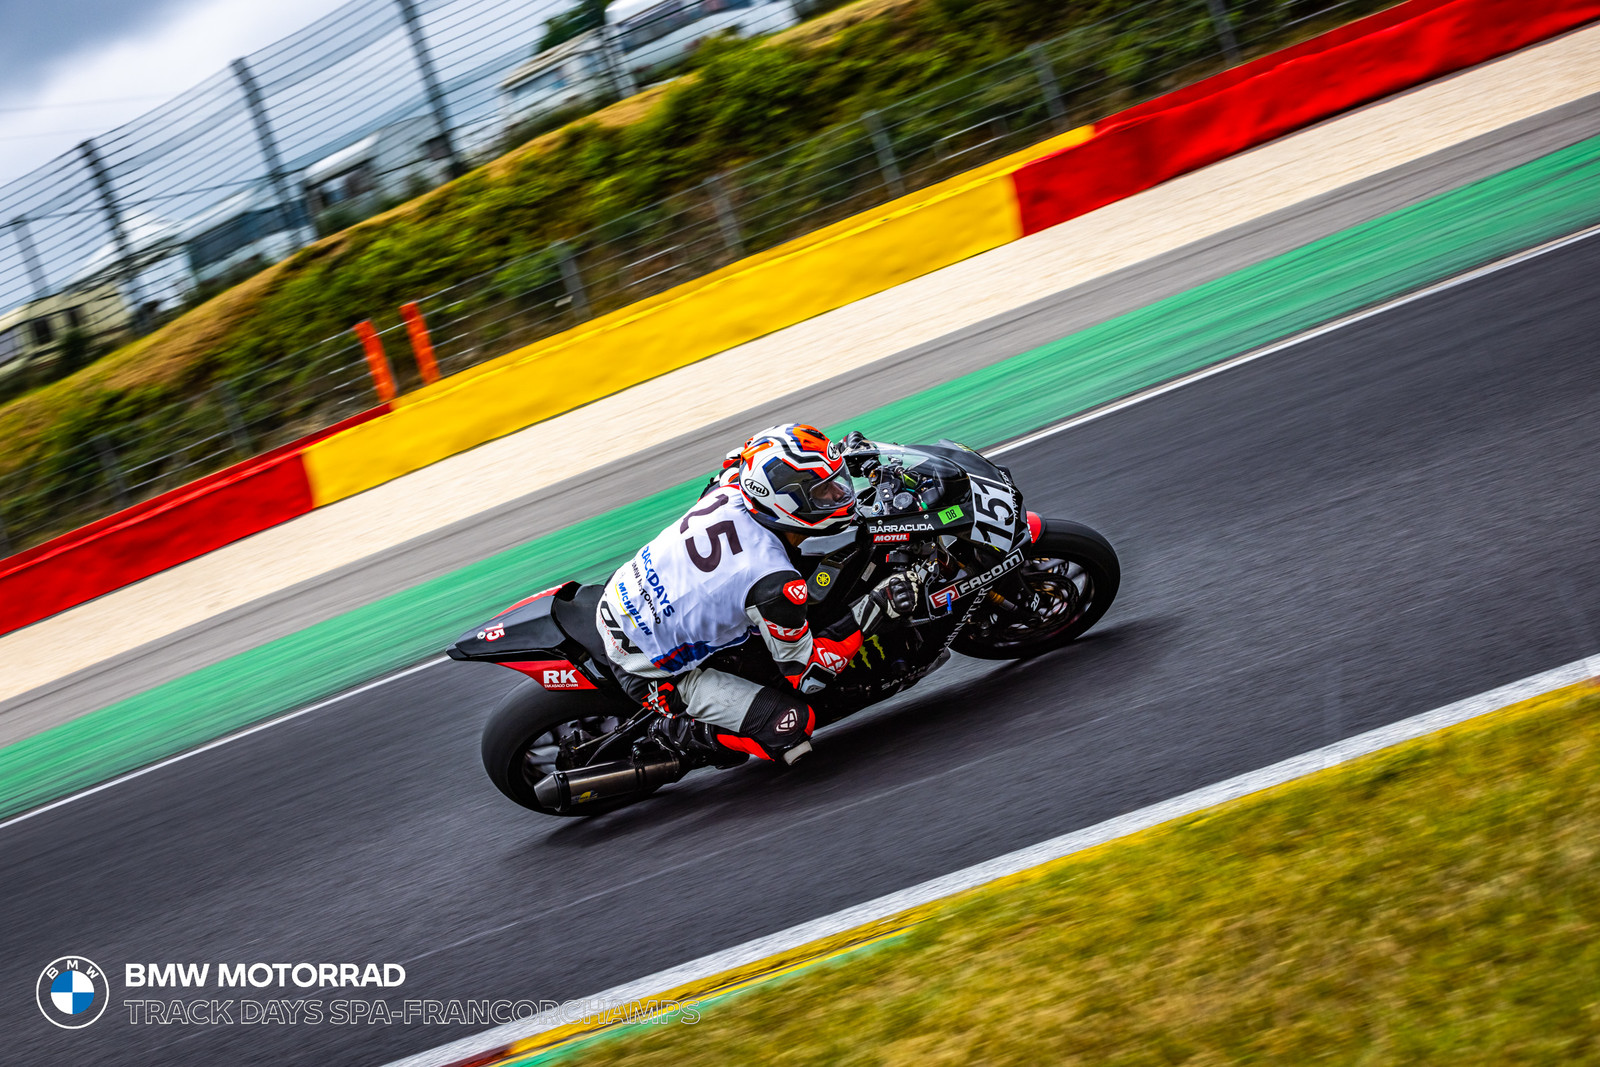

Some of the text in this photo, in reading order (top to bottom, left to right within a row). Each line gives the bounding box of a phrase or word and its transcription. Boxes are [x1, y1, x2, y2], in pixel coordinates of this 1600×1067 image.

[746, 480, 766, 495] Arai
[969, 474, 1015, 544] 151
[869, 523, 934, 534] BARRACUDA
[874, 533, 908, 542] MOTUL
[959, 553, 1021, 594] FACOM
[618, 582, 653, 636] MICHELIN
[543, 669, 578, 684] RK
